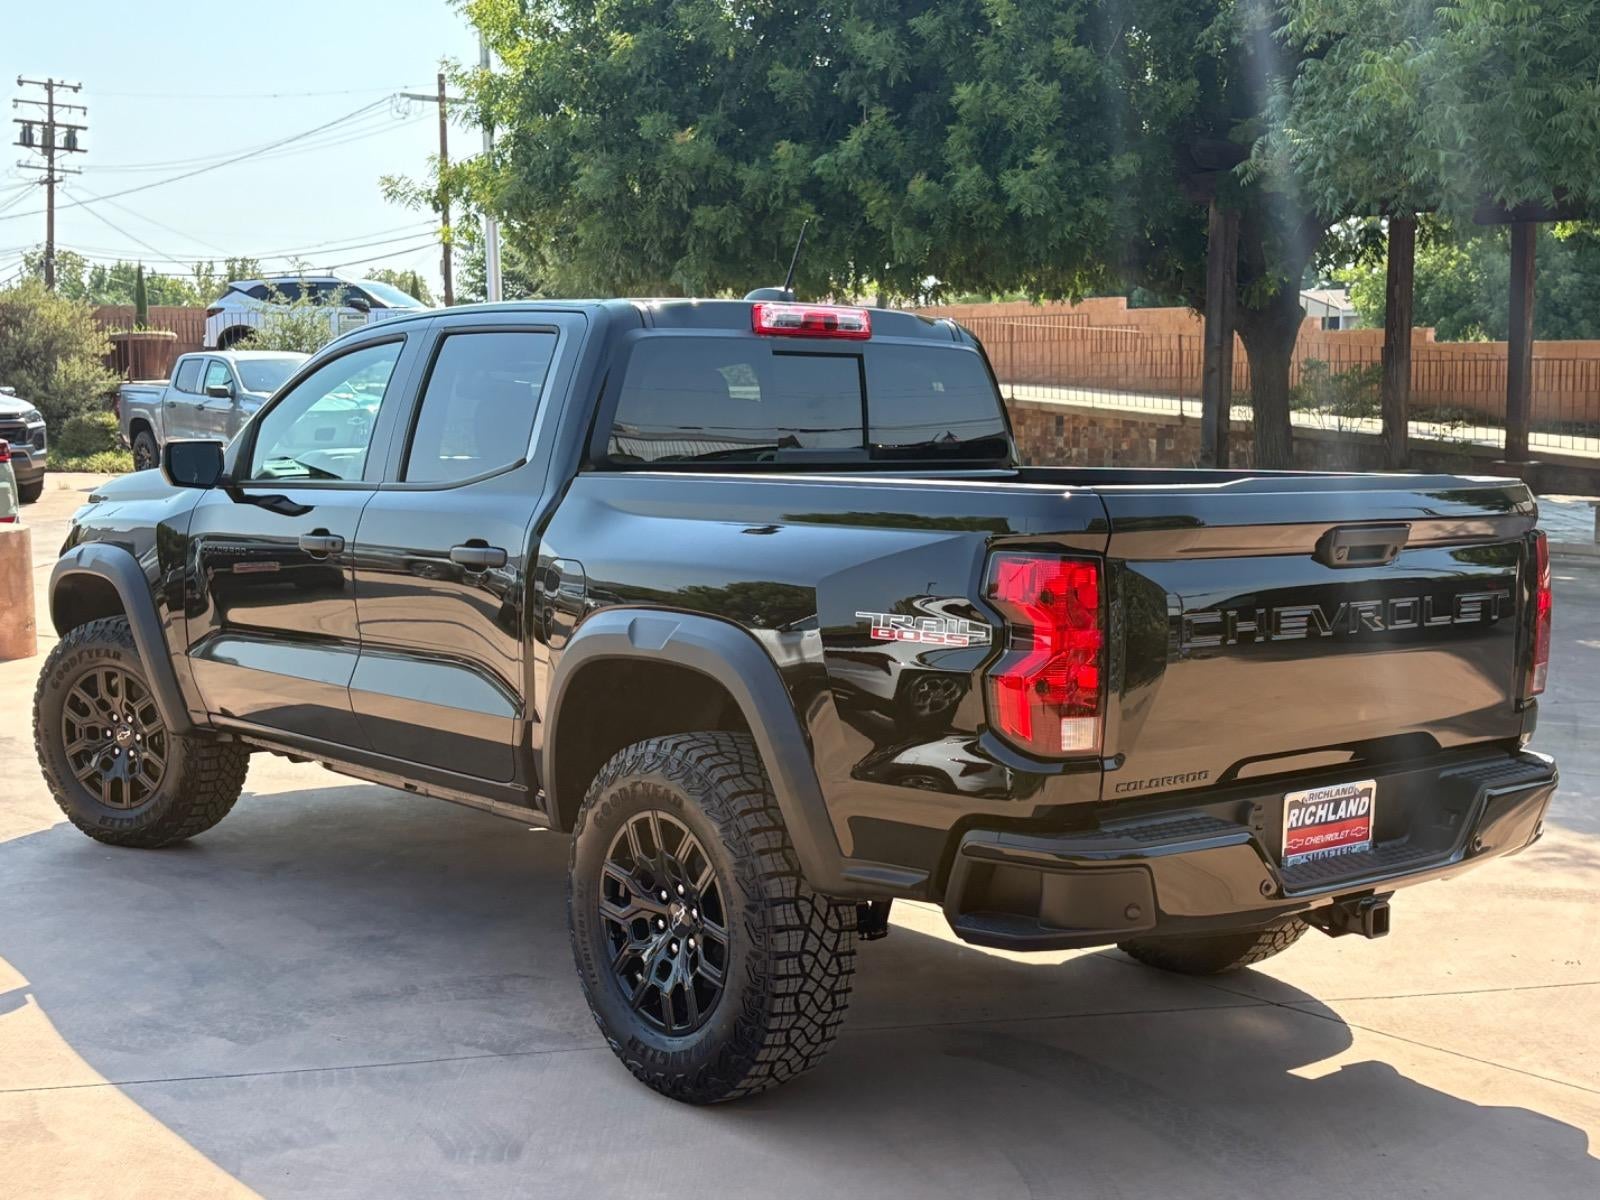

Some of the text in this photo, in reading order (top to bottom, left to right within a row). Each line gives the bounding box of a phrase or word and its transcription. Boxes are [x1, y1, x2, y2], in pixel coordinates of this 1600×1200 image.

[855, 611, 992, 645] TRAIL
[1183, 591, 1509, 649] CHEVROLET
[870, 626, 969, 647] BOSS
[1115, 770, 1209, 793] COLORADO
[1309, 785, 1355, 801] RICHLAND
[1288, 796, 1369, 828] RICHLAND
[1305, 830, 1349, 845] CHEVROLET
